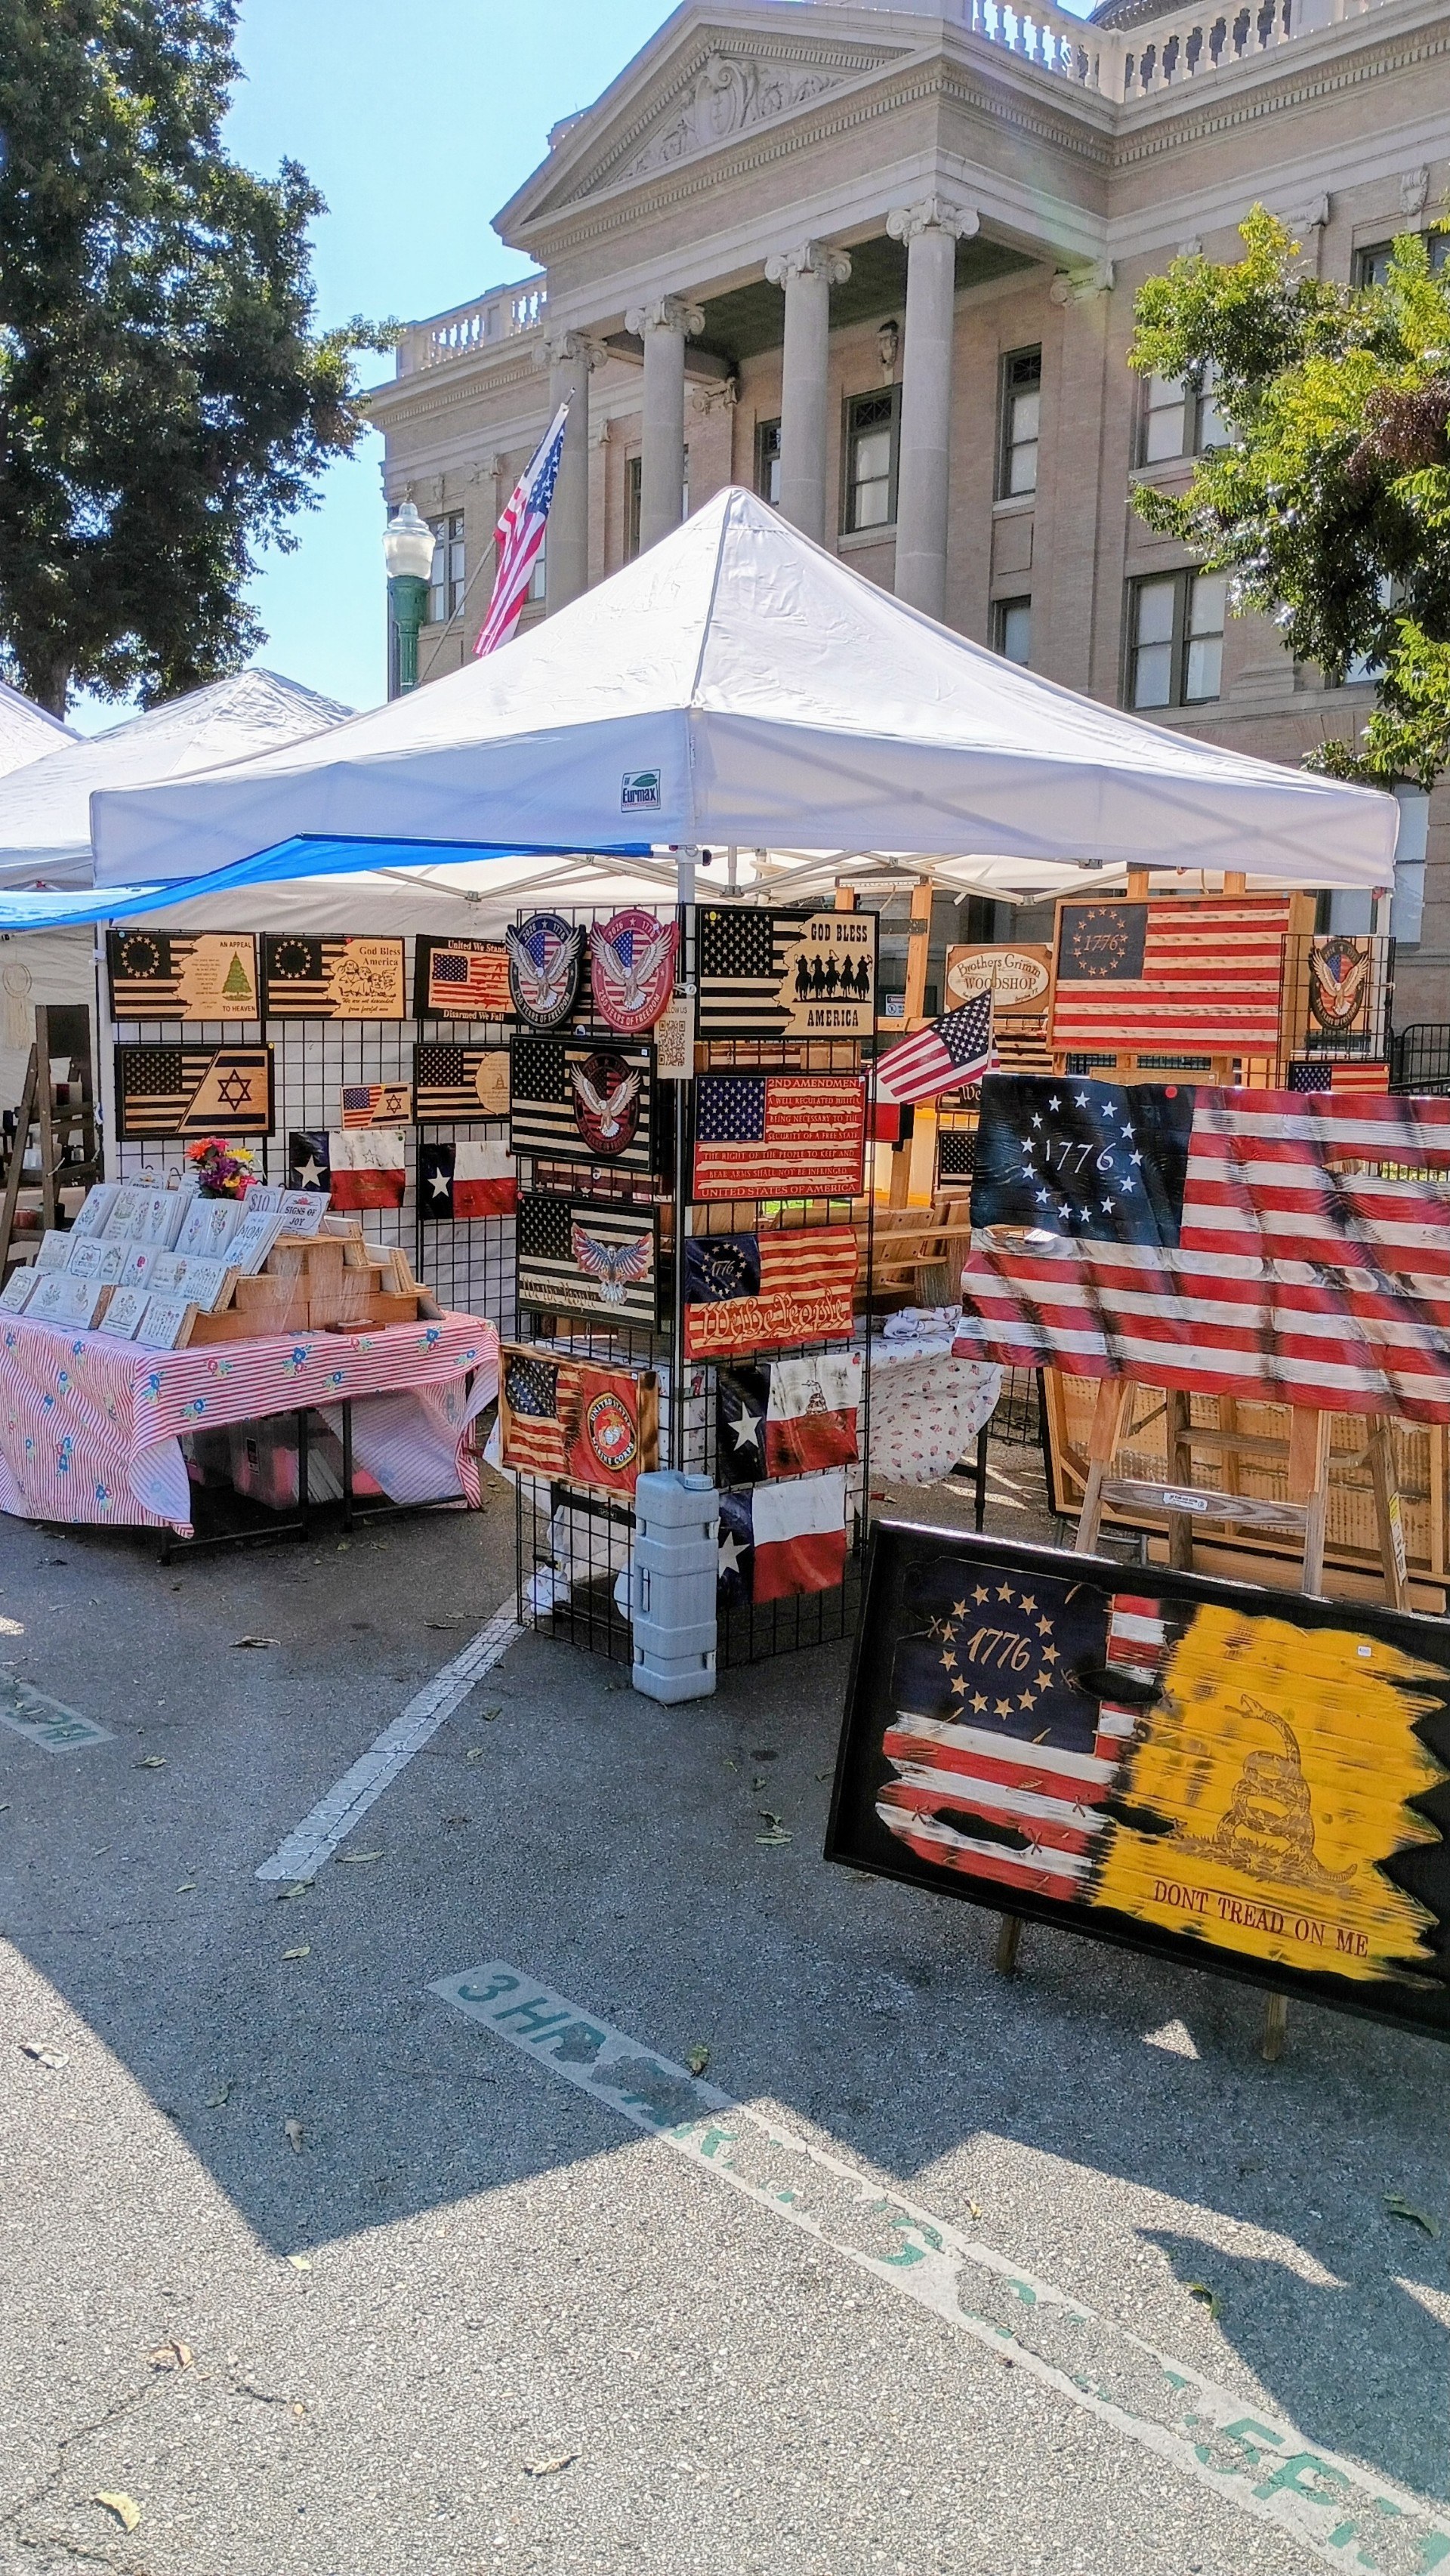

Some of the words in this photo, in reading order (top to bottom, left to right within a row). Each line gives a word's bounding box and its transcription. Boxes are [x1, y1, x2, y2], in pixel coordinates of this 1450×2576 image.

[622, 788, 656, 804] Eurmax
[608, 921, 623, 939] 2026
[811, 924, 831, 941] GOD
[836, 924, 868, 942] BLESS
[448, 940, 471, 950] United
[474, 942, 484, 952] We
[486, 944, 507, 953] Stand
[1084, 934, 1119, 951] 1776
[362, 958, 398, 966] America
[957, 955, 1002, 977] Brothers
[1004, 954, 1041, 978] Grimm
[443, 1010, 477, 1020] Disarmed
[490, 1013, 504, 1021] Fall
[523, 1005, 538, 1022] YEARS
[539, 1015, 548, 1023] OF
[548, 992, 571, 1022] FREEDOM
[606, 1006, 625, 1025] YEARS
[625, 1017, 634, 1026] OF
[635, 994, 661, 1025] FREEDOM
[680, 1006, 687, 1014] US
[807, 1010, 859, 1027] AMERICA
[792, 1079, 861, 1087] AMENDMENT
[722, 1152, 745, 1160] RIGHT
[779, 1150, 806, 1158] PEOPLE
[808, 1149, 818, 1158] TO
[1045, 1139, 1116, 1174] 1776
[702, 1187, 745, 1197] UNITED
[748, 1186, 788, 1195] STATES
[791, 1186, 805, 1194] OF
[806, 1184, 856, 1193] AMERICA
[249, 1193, 270, 1211] $10
[285, 1206, 305, 1215] SIGNS
[237, 1224, 264, 1239] MOM
[711, 1260, 735, 1276] 1776
[699, 1302, 741, 1344] We
[736, 1297, 774, 1338] the
[774, 1287, 846, 1339] People
[590, 1398, 612, 1421] UNITED
[614, 1442, 634, 1464] CORPS
[967, 1627, 1032, 1671] 1776
[1152, 1880, 1208, 1914] DONT
[1217, 1896, 1284, 1935] TREAD
[1294, 1918, 1325, 1946] ON
[1334, 1928, 1368, 1958] ME
[458, 1974, 520, 2002] 3
